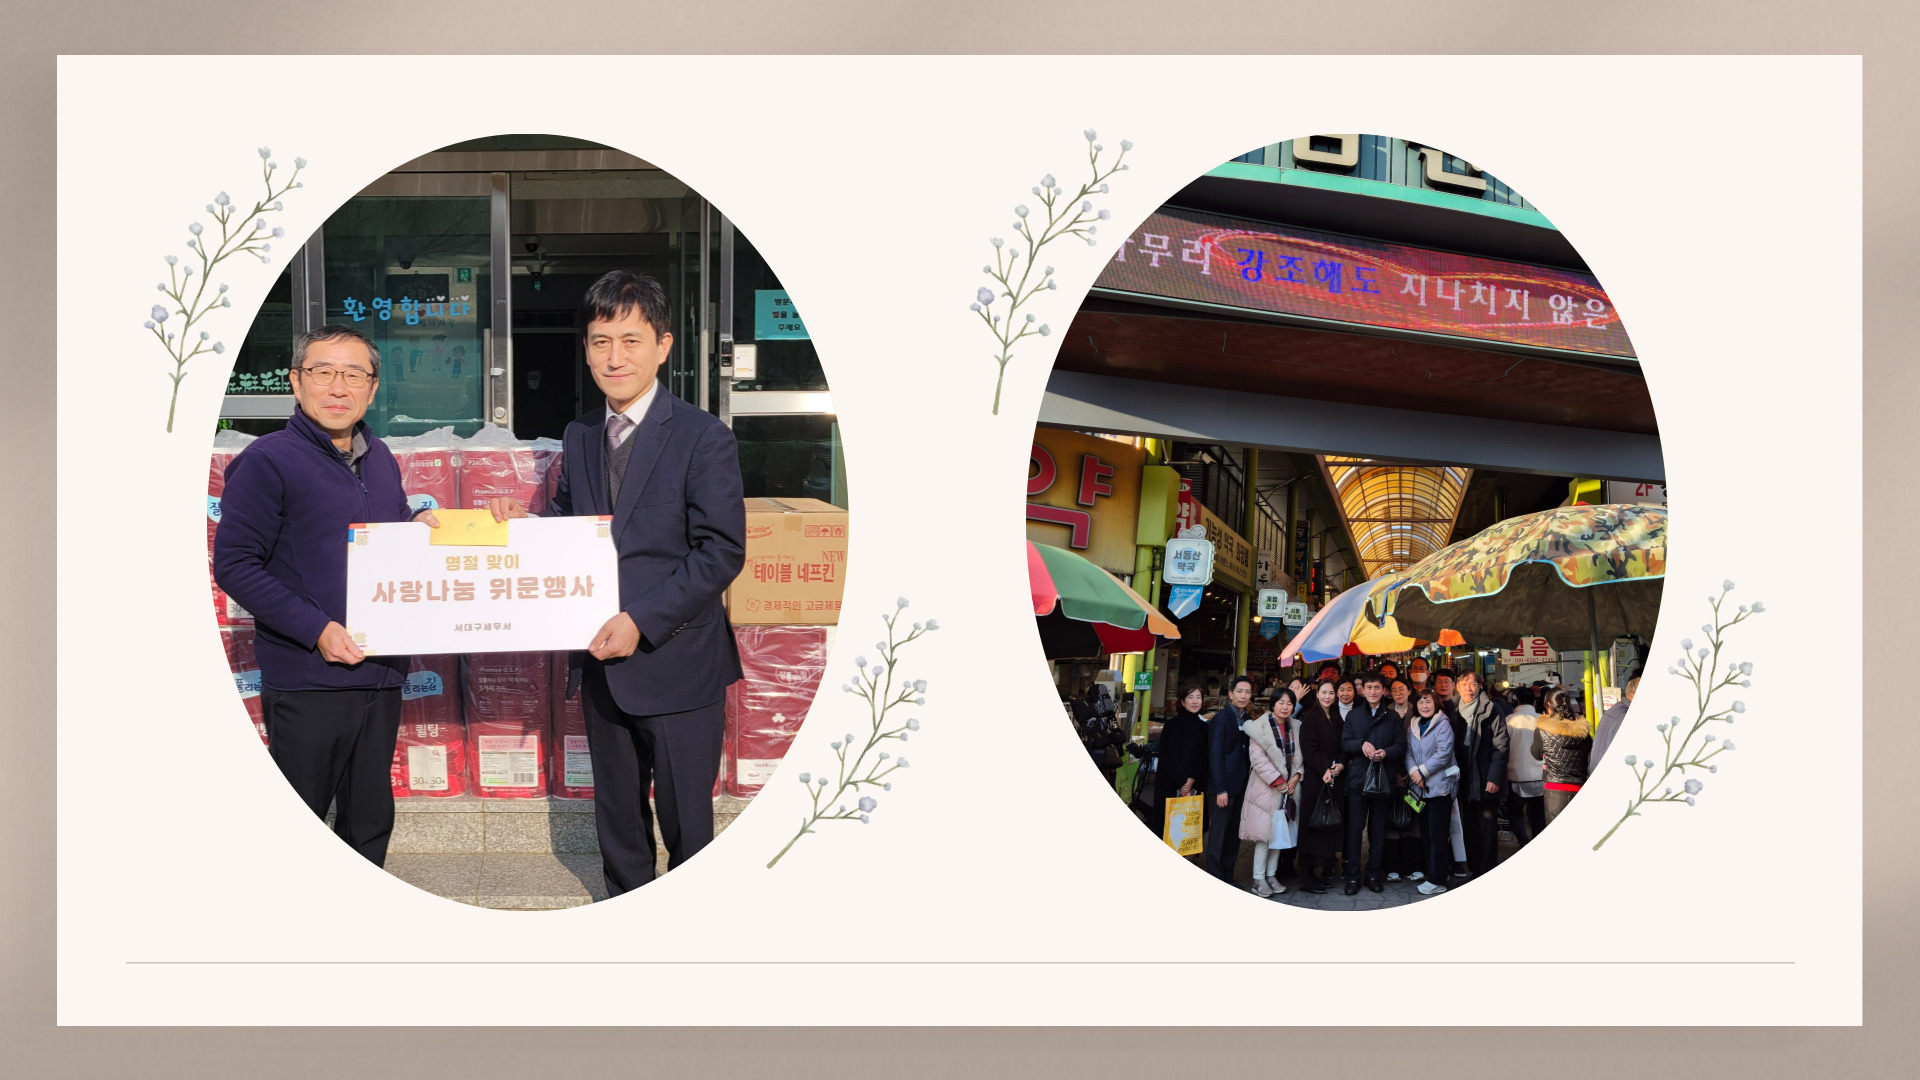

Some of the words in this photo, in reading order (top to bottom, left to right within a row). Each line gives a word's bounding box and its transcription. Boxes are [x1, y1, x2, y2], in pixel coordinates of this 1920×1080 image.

[1237, 248, 1380, 294] 강조해도
[1399, 273, 1531, 320] 지나치지
[1549, 294, 1607, 330] 않은
[343, 296, 471, 325] 환영합니다
[821, 550, 846, 562] NEW
[1173, 550, 1202, 560] 서동산
[445, 556, 479, 571] 명절
[486, 554, 520, 570] 맞이
[1177, 562, 1196, 572] 약국
[754, 563, 792, 583] 테이블
[797, 563, 835, 583] 네프킨
[371, 579, 475, 603] 사랑나눔
[489, 575, 595, 600] 위문행사
[763, 600, 801, 611] 경제적인
[454, 622, 512, 632] 서대구세무서
[1181, 838, 1199, 846] SAVE
